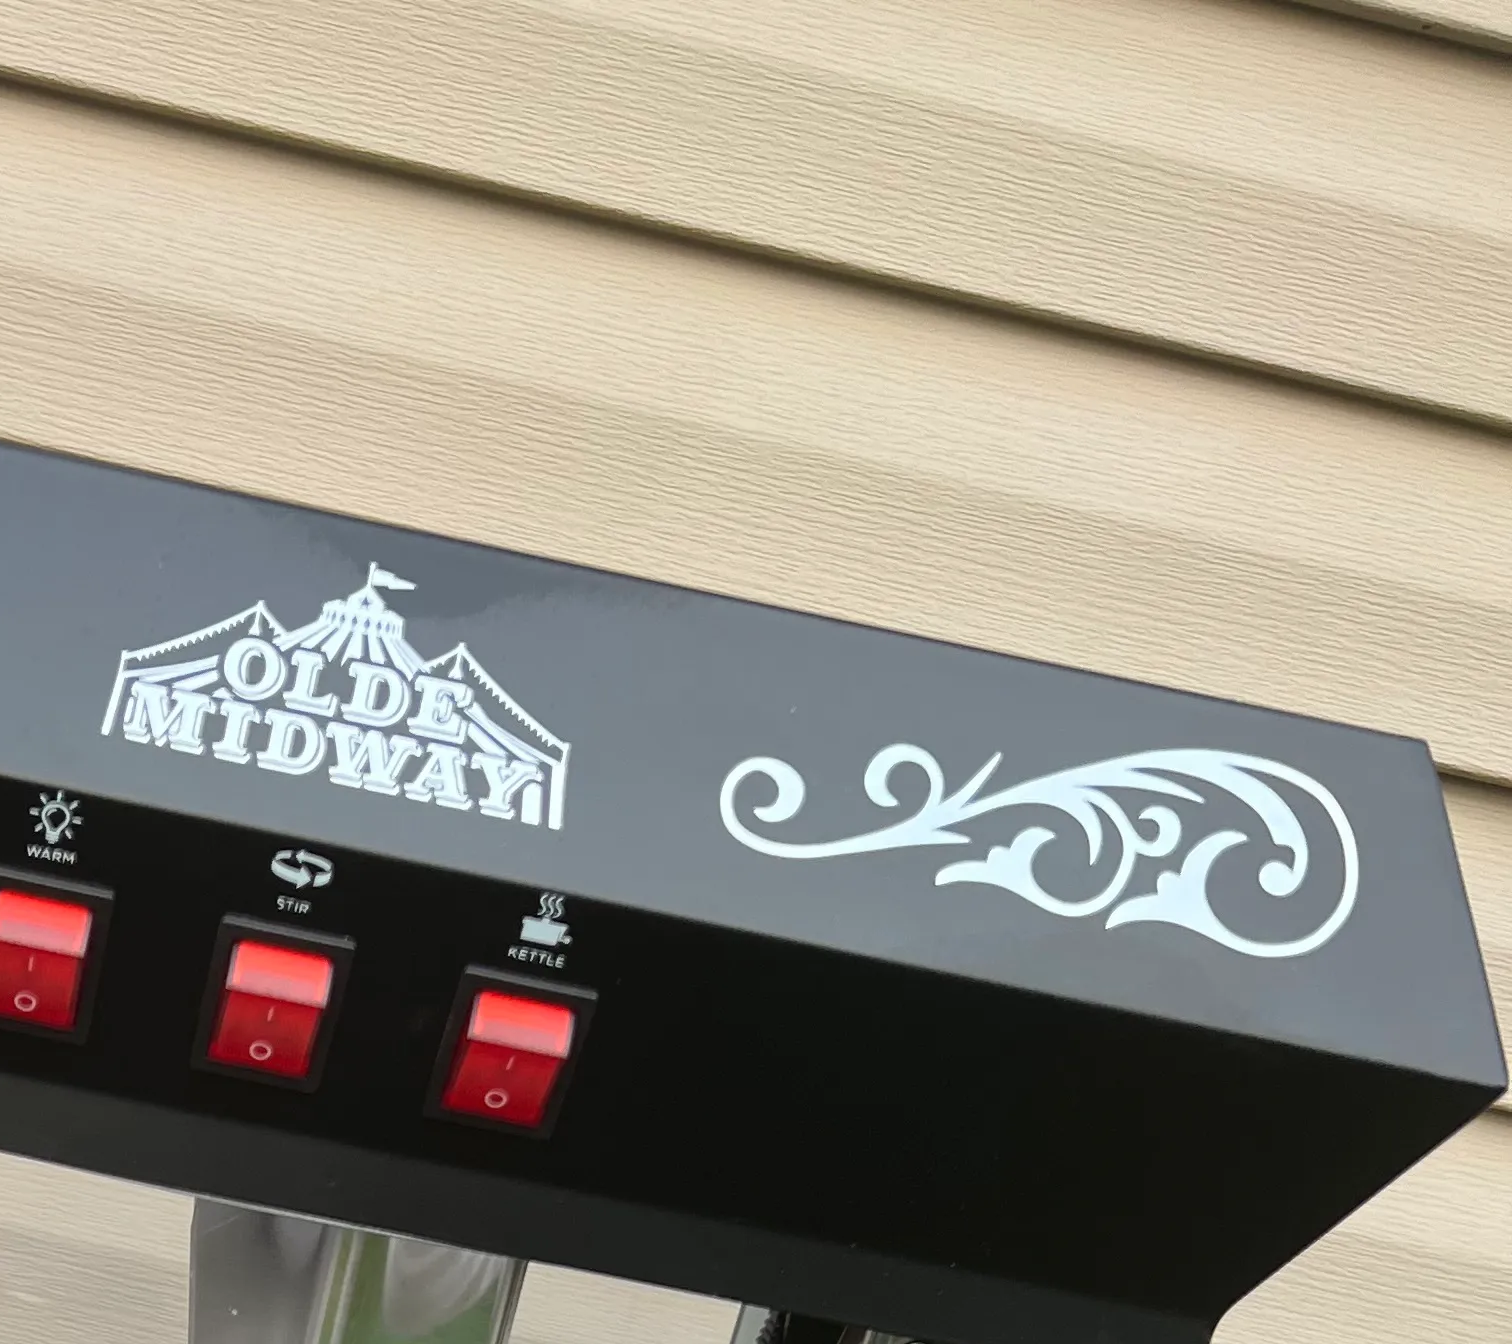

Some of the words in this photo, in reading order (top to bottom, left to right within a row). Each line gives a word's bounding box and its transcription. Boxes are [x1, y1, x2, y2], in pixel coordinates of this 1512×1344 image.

[223, 635, 474, 745] OLDE
[122, 681, 541, 820] MIDWAY
[26, 844, 76, 865] WARM
[276, 897, 310, 914] STIR
[507, 946, 566, 969] KETTLE
